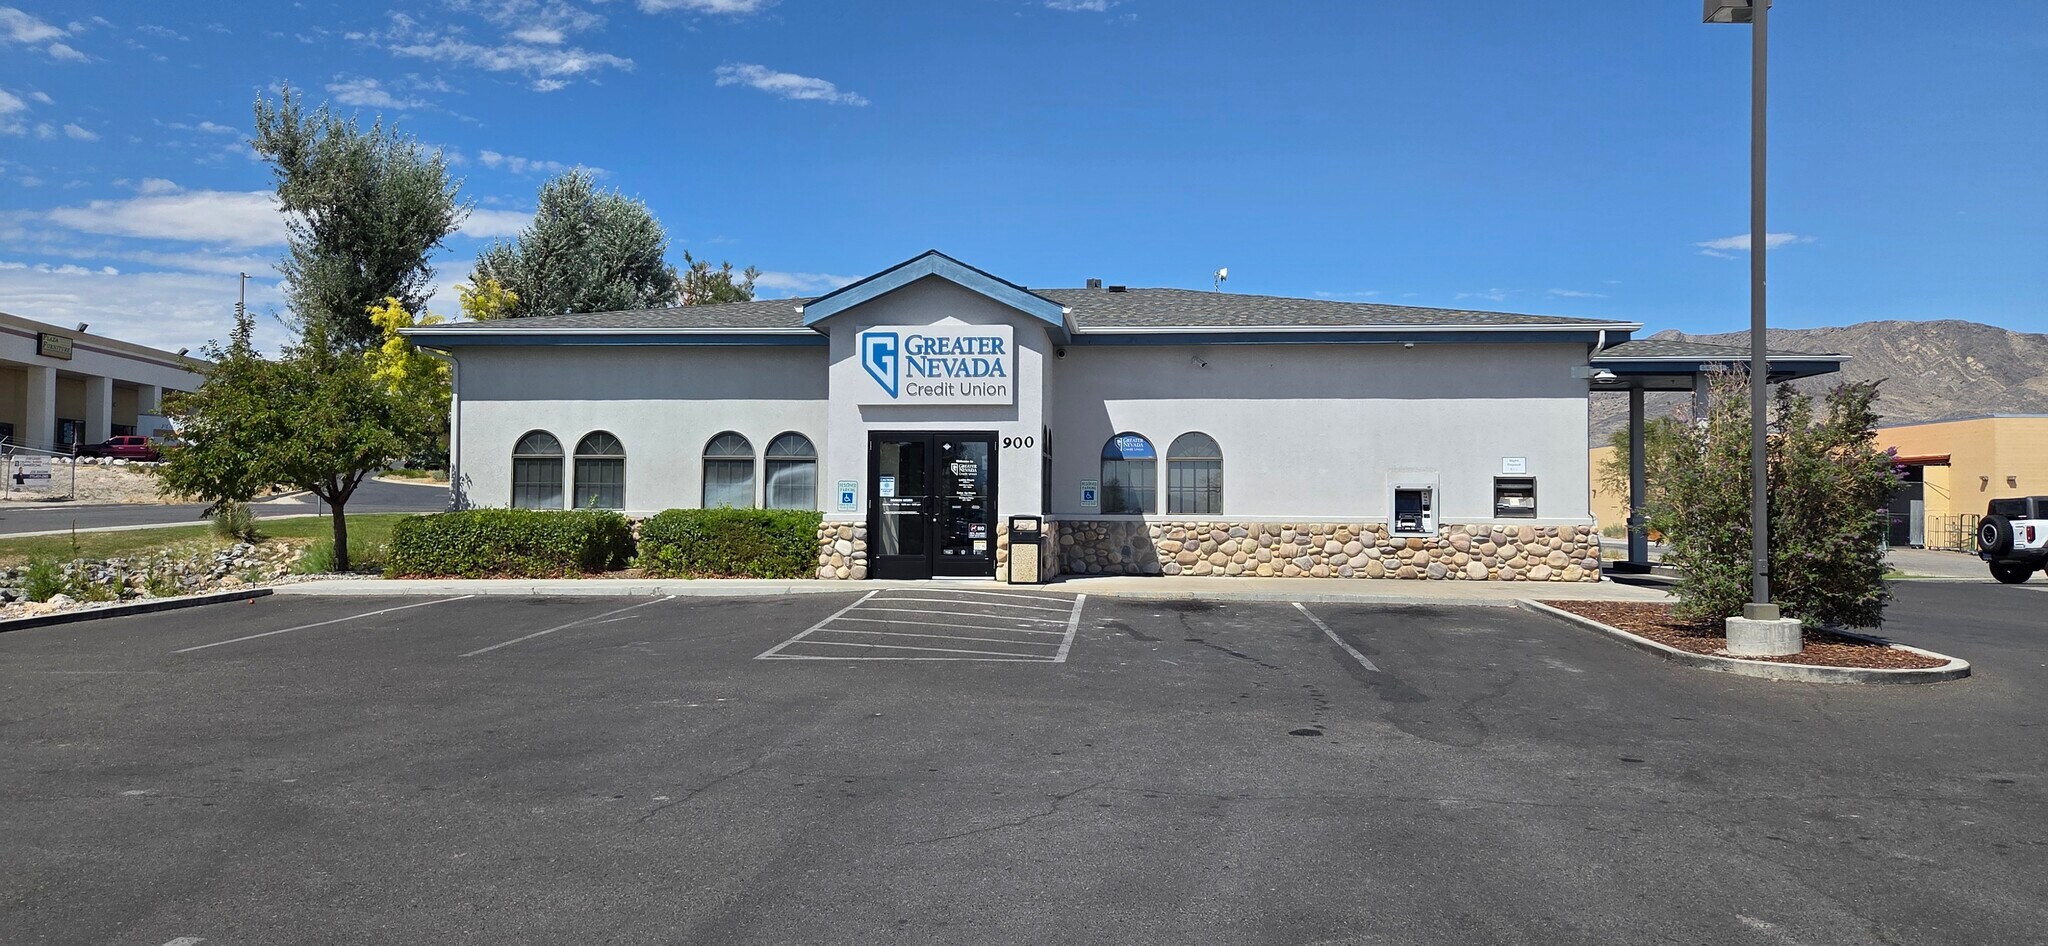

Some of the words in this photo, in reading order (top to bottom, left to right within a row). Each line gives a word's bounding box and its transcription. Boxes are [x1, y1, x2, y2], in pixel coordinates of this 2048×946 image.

[43, 334, 59, 342] PLAZA
[43, 341, 70, 352] FURNITURE
[904, 334, 1006, 356] GREATER
[906, 356, 1007, 378] NEVADA
[906, 382, 954, 396] Credit
[960, 382, 1007, 396] Union
[1003, 436, 1034, 449] 900
